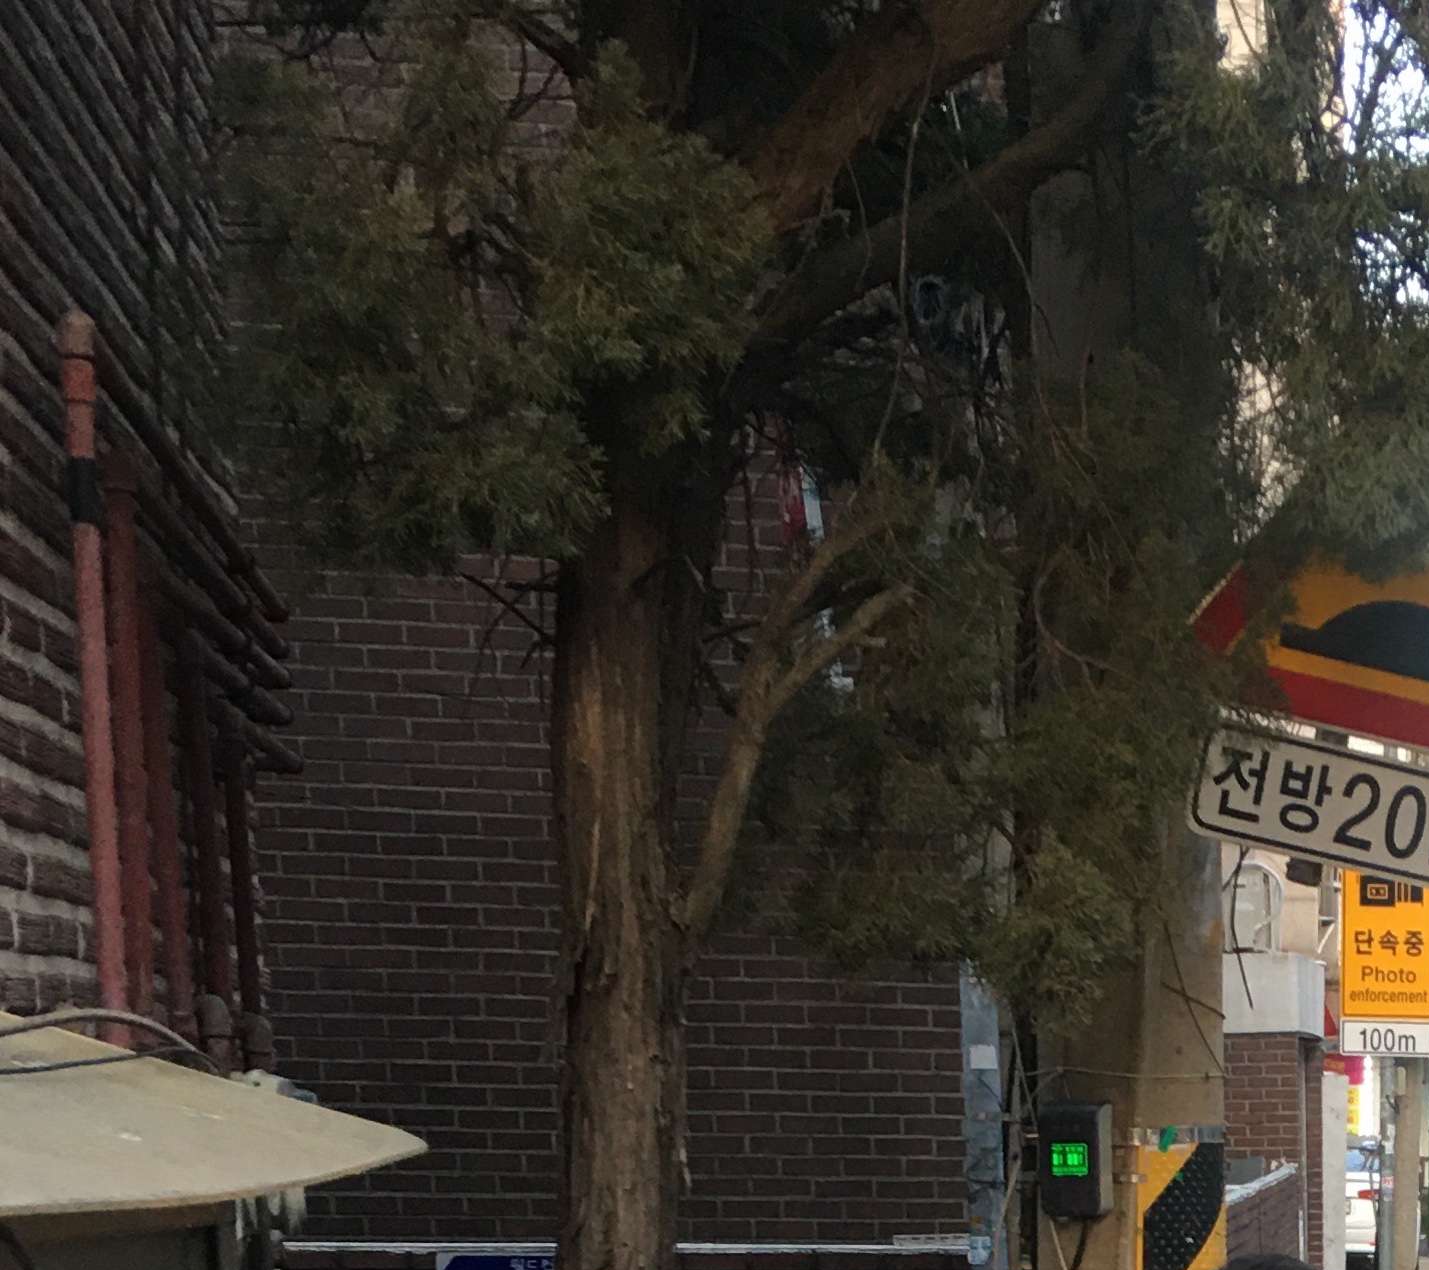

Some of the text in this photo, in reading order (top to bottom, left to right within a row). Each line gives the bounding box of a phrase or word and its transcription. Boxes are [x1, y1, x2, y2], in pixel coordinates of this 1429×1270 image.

[1354, 928, 1424, 957] 단속중
[1361, 965, 1417, 983] Photo
[1349, 987, 1428, 1004] enforcement
[1359, 1027, 1417, 1052] 100m
